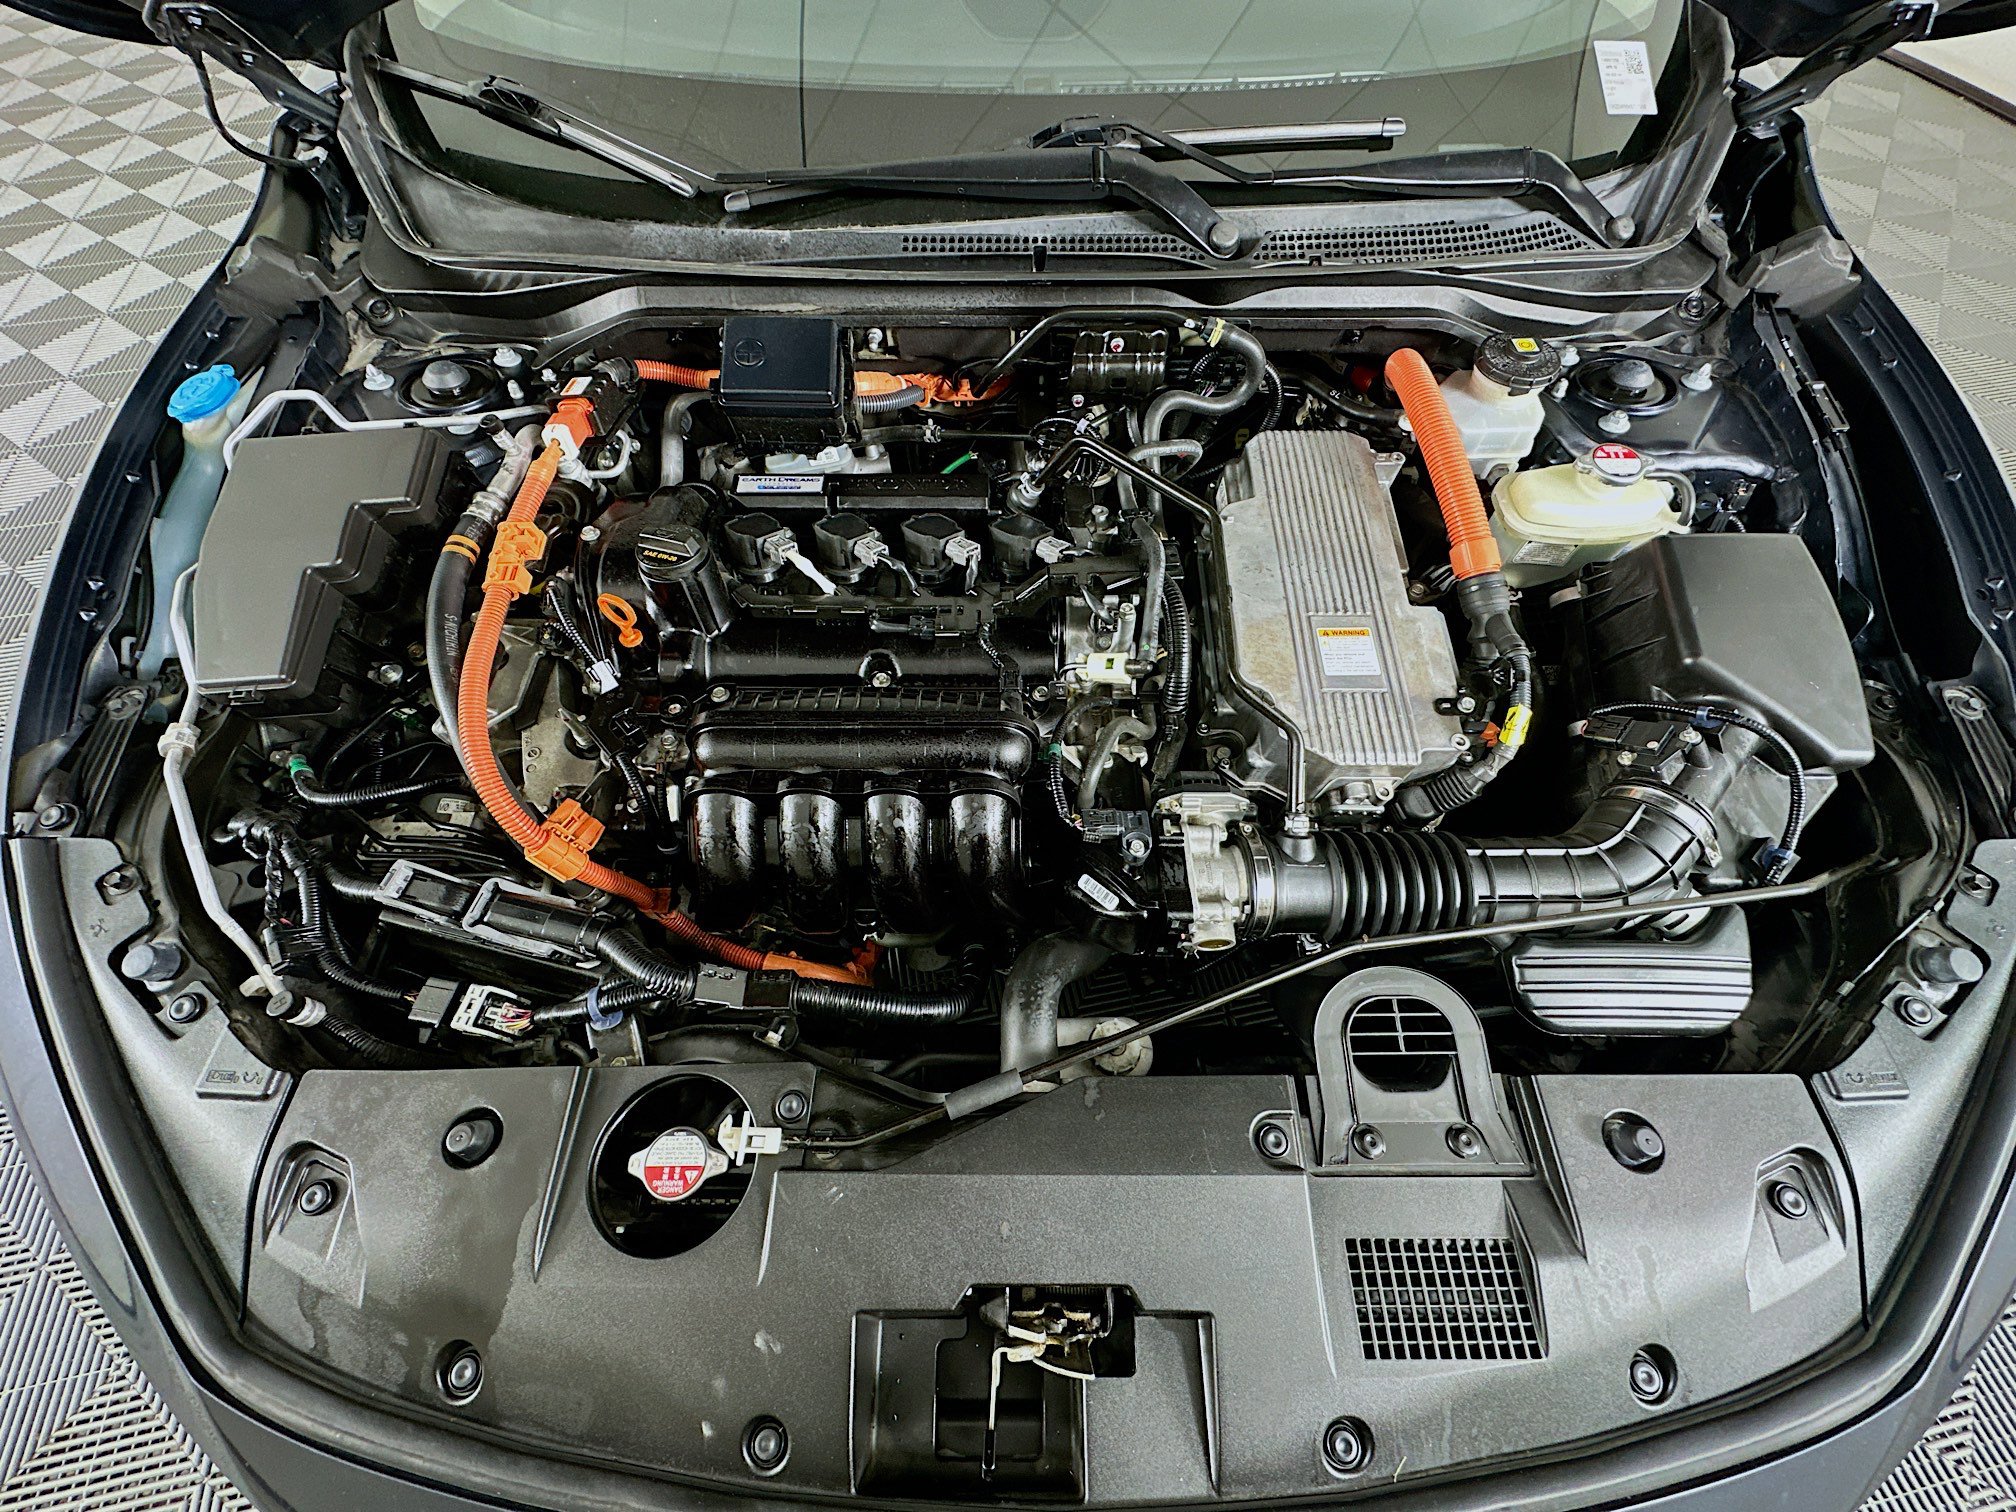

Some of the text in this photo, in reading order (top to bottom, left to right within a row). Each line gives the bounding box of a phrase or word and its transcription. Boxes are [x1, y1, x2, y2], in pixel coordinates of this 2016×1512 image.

[847, 478, 976, 491] HONDA
[643, 549, 678, 562] SAE 0W-20
[657, 1186, 683, 1194] DANGER
